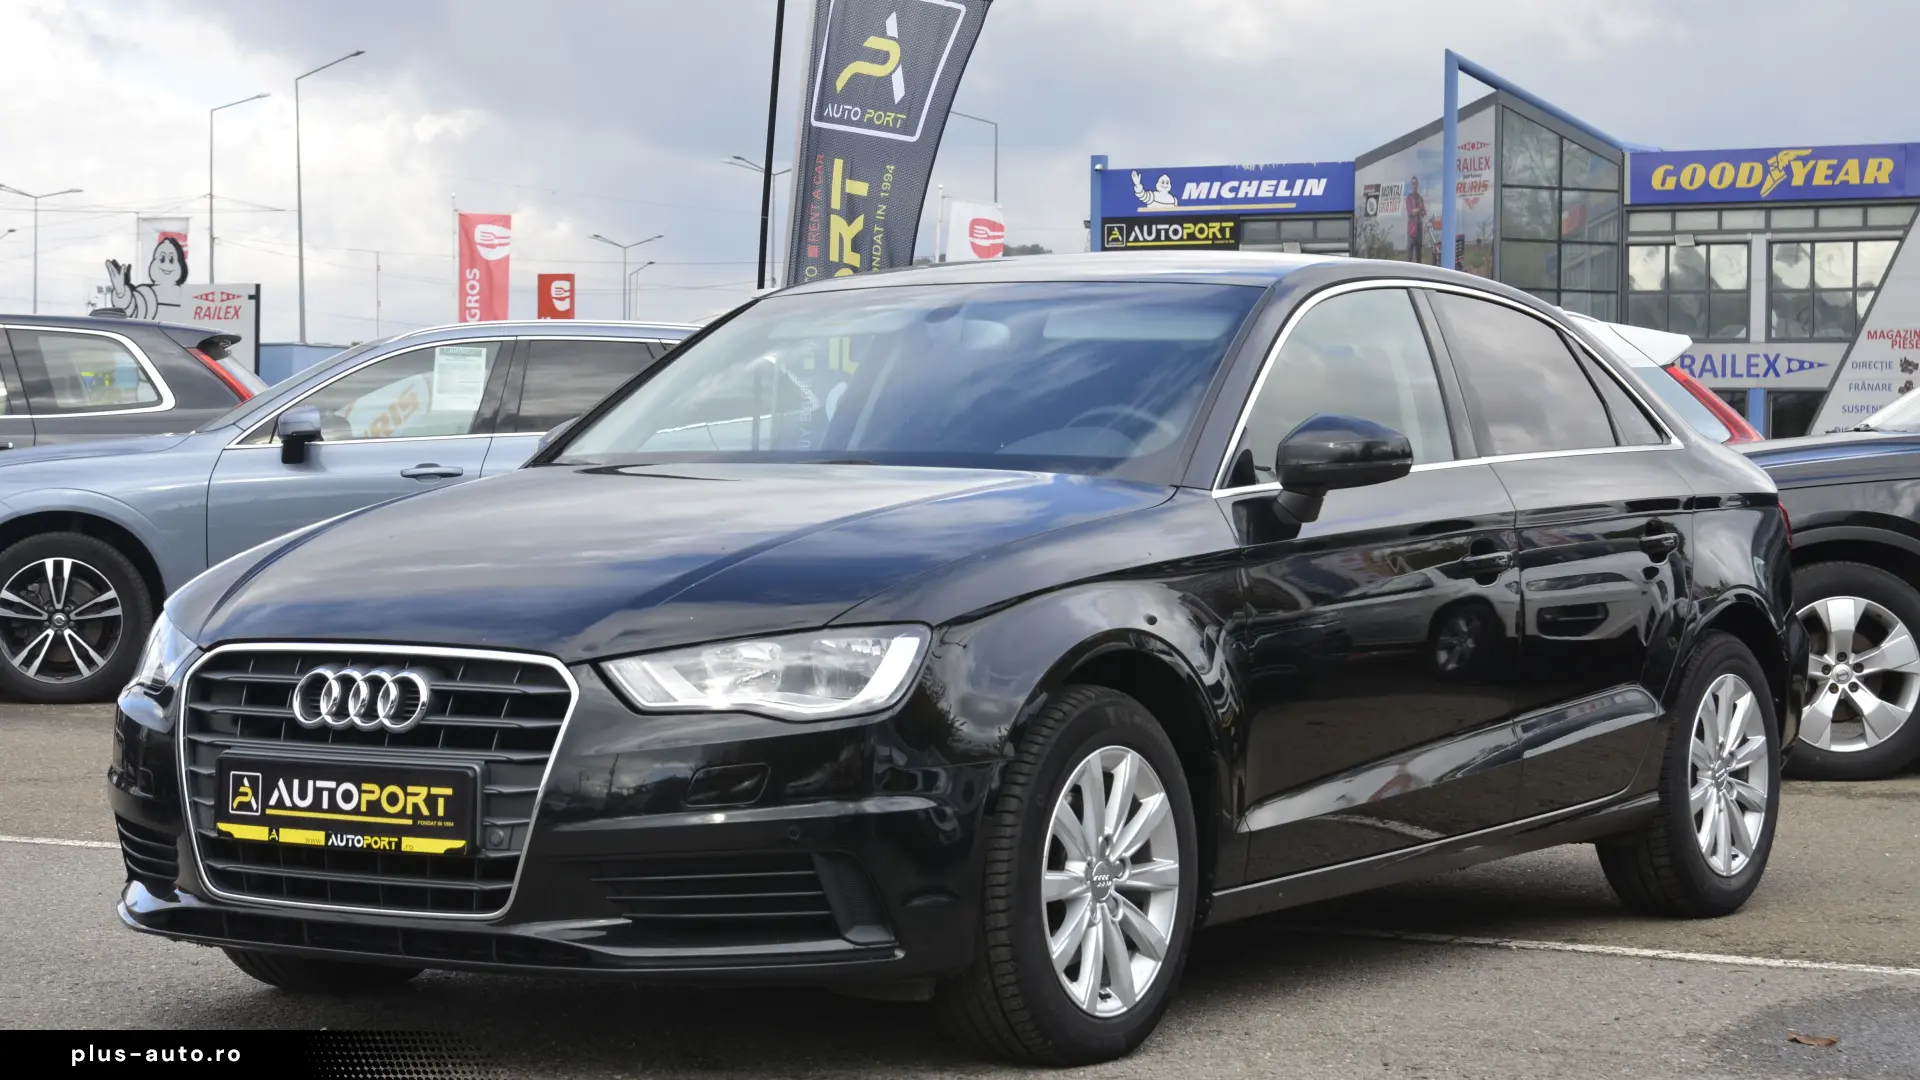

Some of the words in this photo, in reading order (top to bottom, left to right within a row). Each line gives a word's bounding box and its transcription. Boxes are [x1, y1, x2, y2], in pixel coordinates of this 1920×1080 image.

[824, 103, 861, 121] AUTO
[863, 109, 907, 128] PORT
[814, 154, 824, 185] CAR
[1456, 156, 1490, 172] RAILEX
[881, 165, 896, 197] 1994
[1181, 178, 1327, 200] MICHELIN
[808, 204, 821, 242] RENT
[876, 204, 887, 219] IN
[1128, 222, 1235, 242] AUTOPORT
[193, 305, 242, 320] RAILEX
[1680, 353, 1781, 378] RAILEX
[268, 778, 453, 817] AUTOPORT
[328, 834, 398, 850] AUTOPORT
